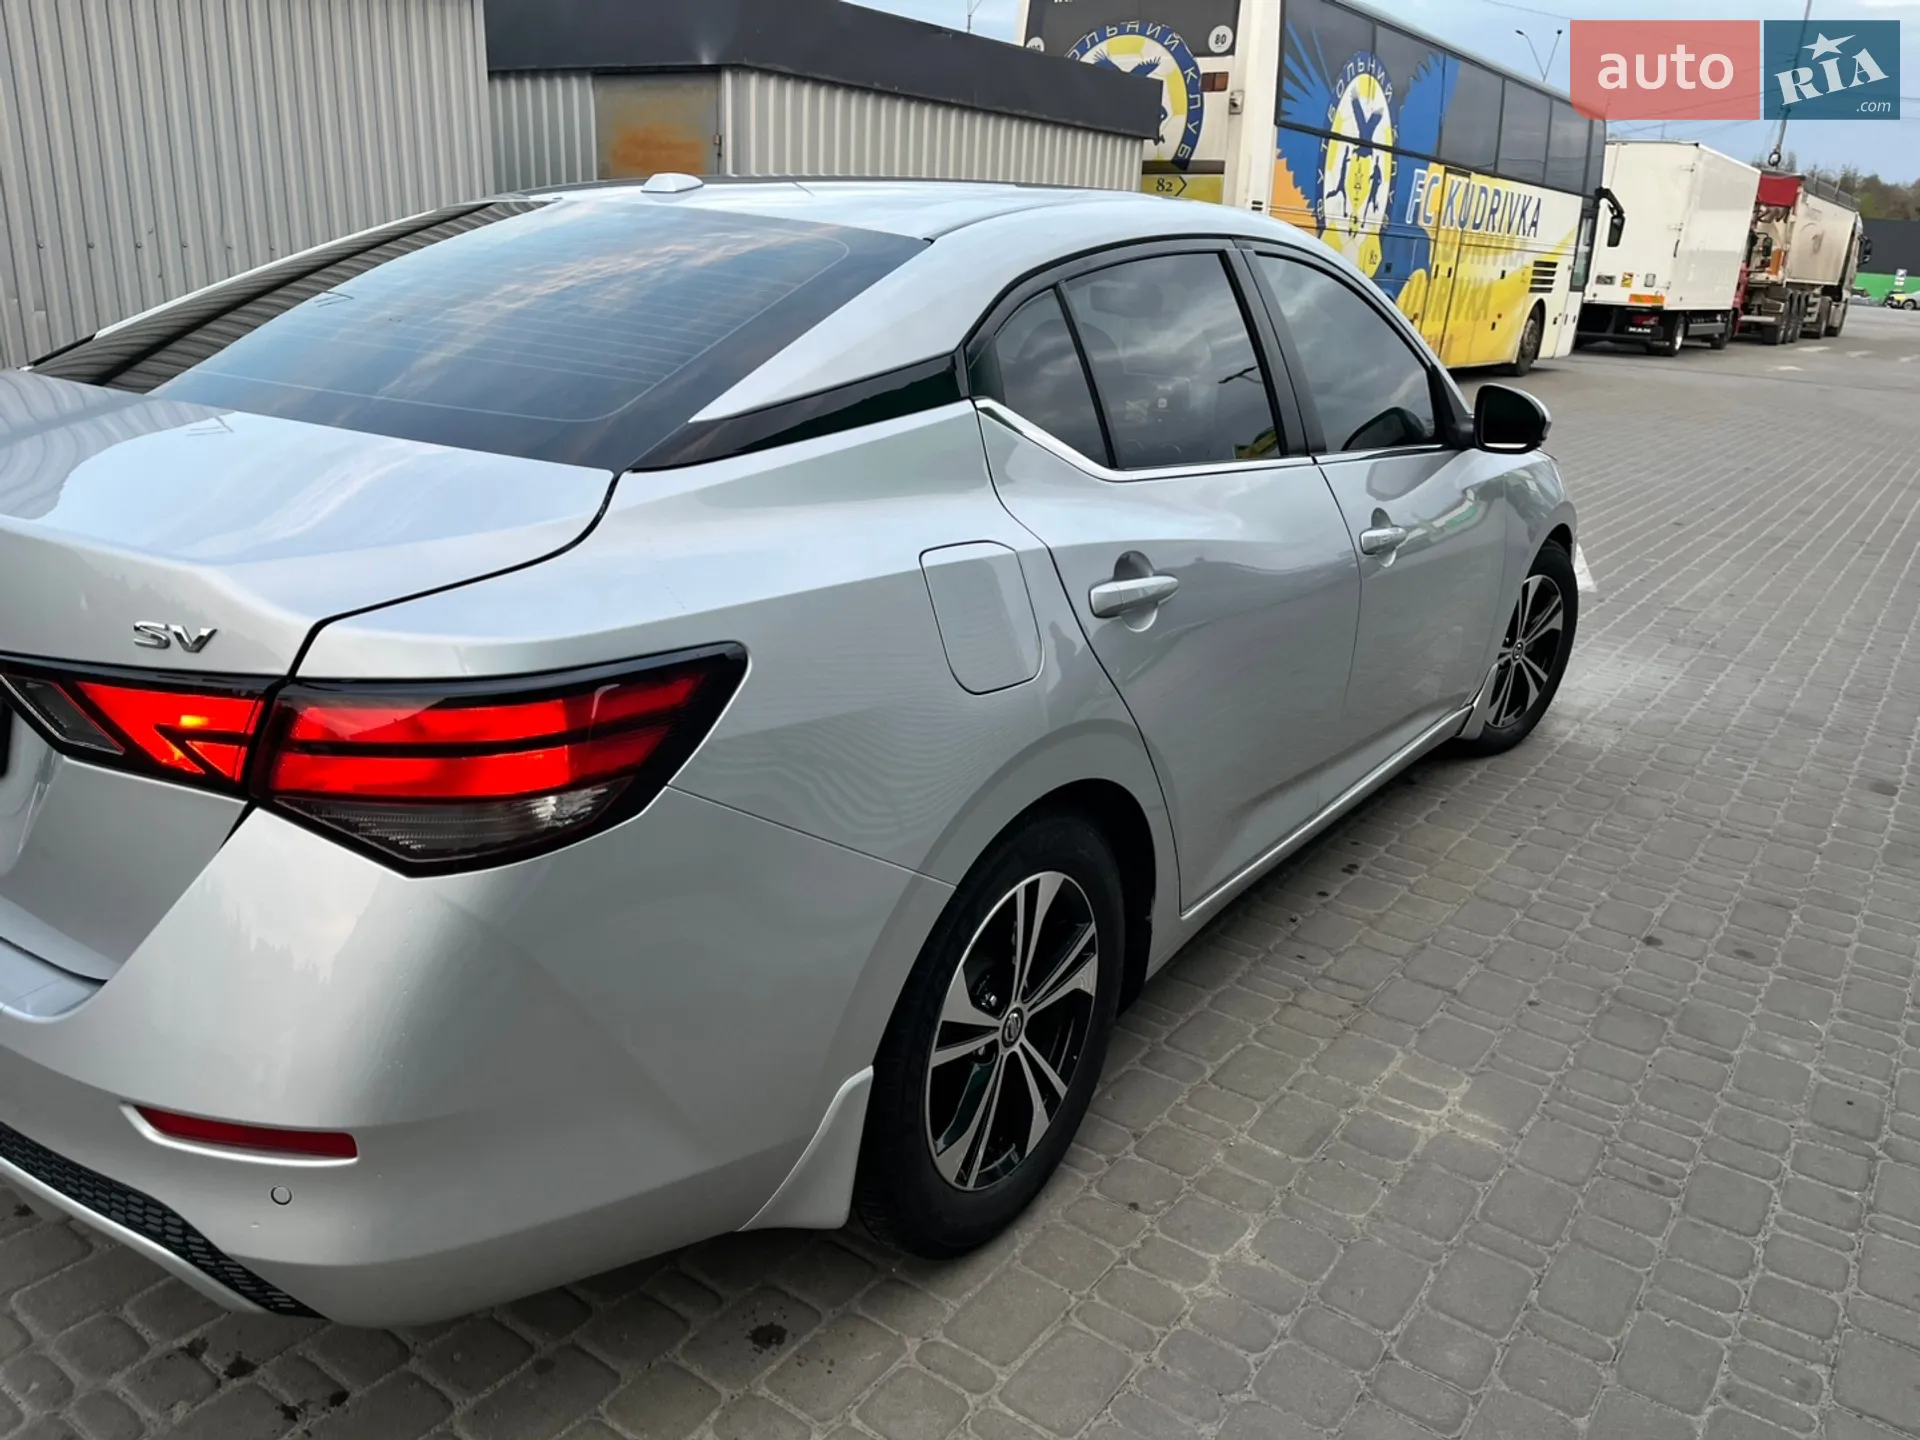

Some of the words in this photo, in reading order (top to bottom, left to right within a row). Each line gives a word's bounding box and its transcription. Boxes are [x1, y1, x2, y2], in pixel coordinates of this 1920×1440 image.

[1214, 34, 1227, 45] 80
[1177, 67, 1202, 159] КЛУБ
[1155, 177, 1173, 192] 82
[1405, 168, 1440, 226] FC
[1441, 178, 1543, 239] KUDRIVKA
[133, 620, 218, 653] SV
